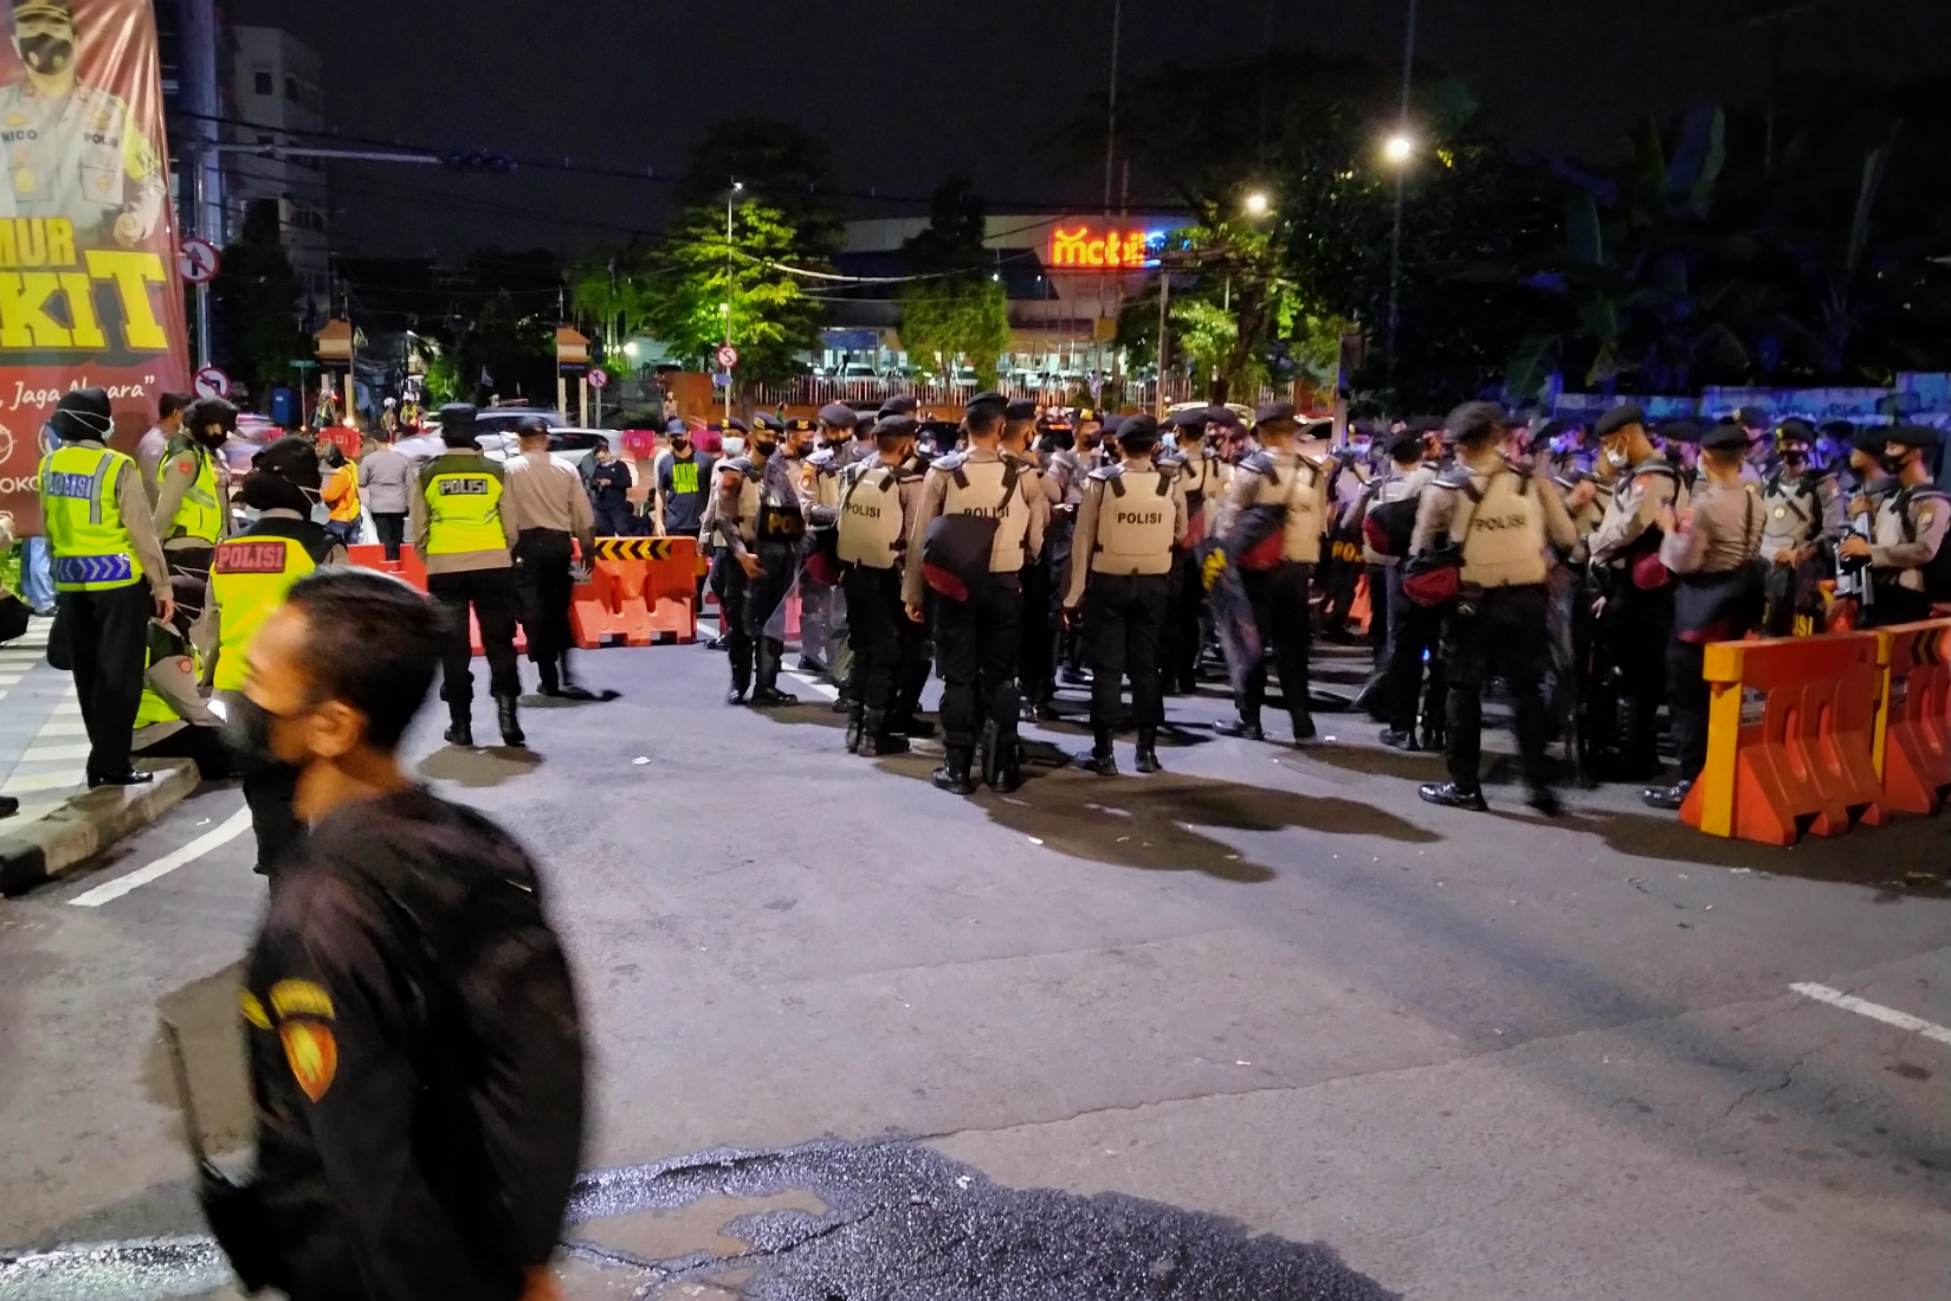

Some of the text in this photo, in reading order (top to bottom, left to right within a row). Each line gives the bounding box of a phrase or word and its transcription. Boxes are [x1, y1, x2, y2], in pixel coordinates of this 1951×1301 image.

[1, 129, 38, 142] NICO
[9, 381, 61, 411] Jaga
[439, 479, 487, 495] POLISI
[846, 502, 881, 519] POLISI
[1117, 512, 1162, 524] POLISI
[217, 546, 284, 568] POLISI
